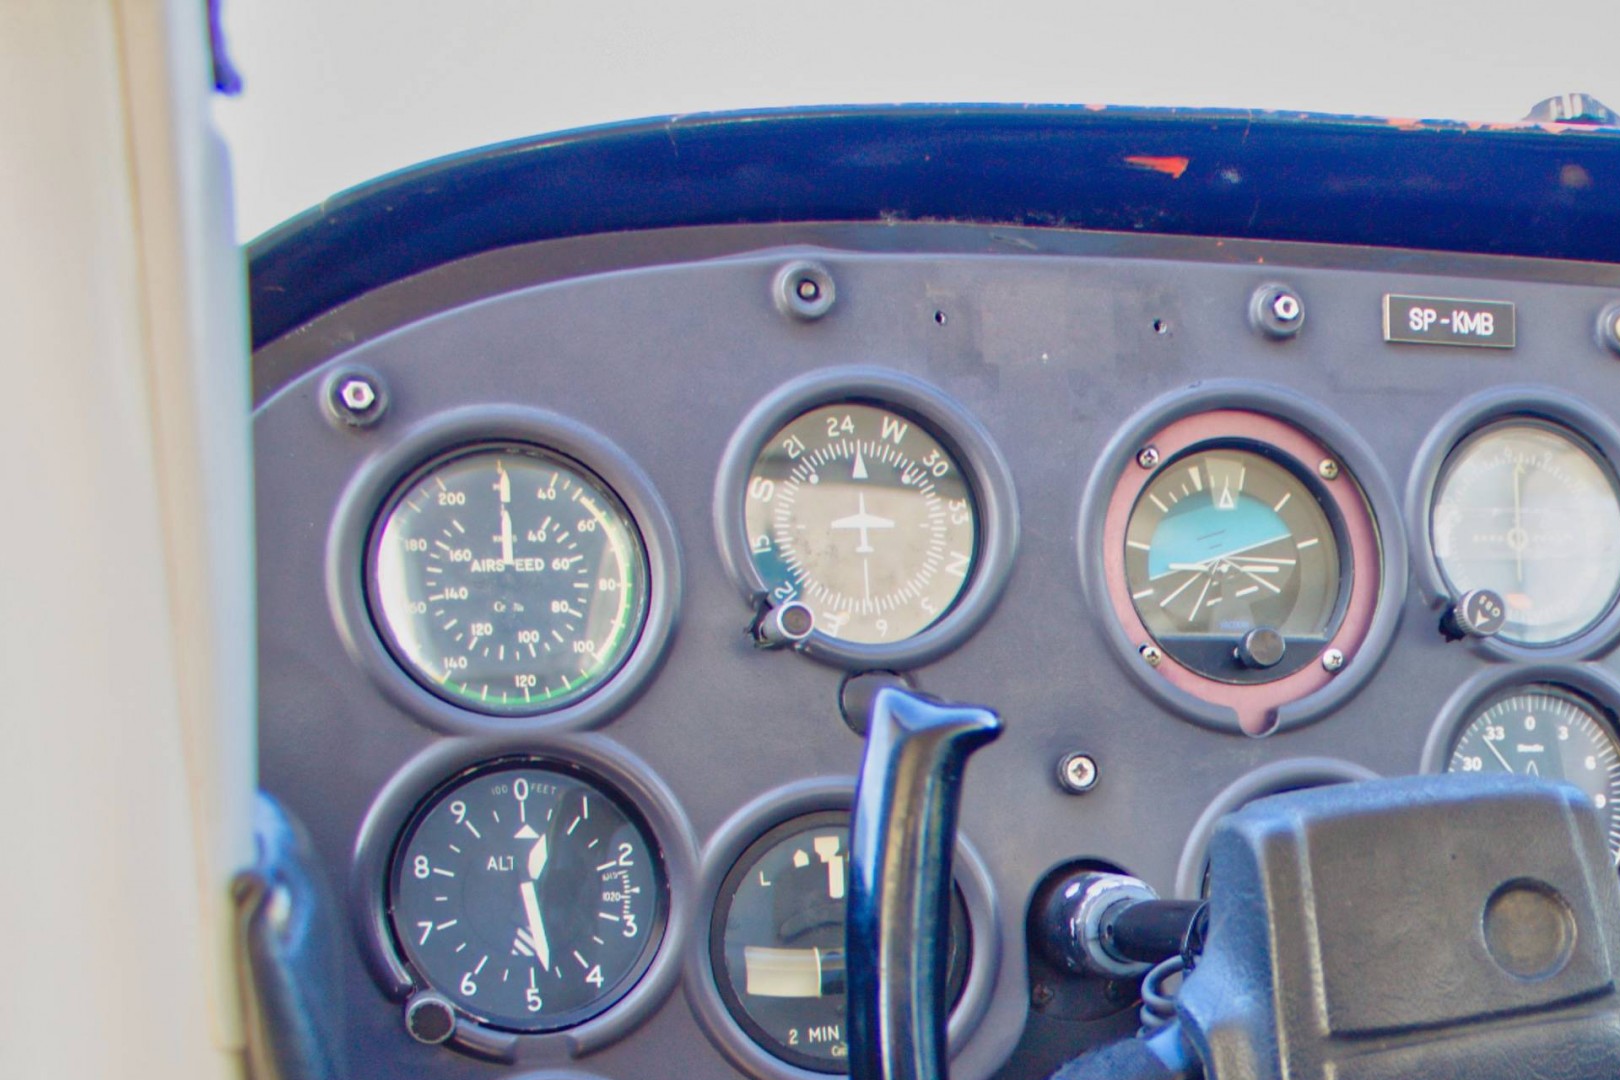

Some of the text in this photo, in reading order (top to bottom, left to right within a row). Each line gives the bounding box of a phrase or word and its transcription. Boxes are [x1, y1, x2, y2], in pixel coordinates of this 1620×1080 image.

[1409, 307, 1494, 336] SP-KMB
[827, 415, 854, 437] 24
[882, 416, 908, 444] W
[783, 435, 805, 459] 21
[922, 449, 949, 478] 30
[438, 492, 466, 505] 200
[537, 488, 556, 500] 40
[949, 499, 969, 525] 33
[577, 519, 596, 532] 60
[528, 530, 546, 542] 40
[404, 539, 427, 551] 180
[450, 550, 472, 562] 160
[552, 559, 570, 571] 60
[599, 579, 616, 591] 80
[444, 588, 468, 599] 140
[404, 602, 427, 614] 60
[551, 601, 568, 613] 80
[471, 624, 493, 636] 120
[518, 631, 540, 643] 100
[573, 641, 595, 653] 100
[444, 657, 467, 669] 140
[515, 675, 536, 688] 120
[1525, 716, 1535, 731] 0
[1485, 726, 1505, 740] 33
[1558, 726, 1568, 740] 3
[1462, 757, 1482, 771] 30
[1585, 756, 1596, 770] 6
[514, 779, 529, 801] 0
[450, 801, 466, 824] 9
[618, 843, 633, 866] 2
[414, 856, 429, 878] 8
[487, 856, 514, 871] ALT
[760, 871, 771, 886] L
[623, 914, 637, 937] 3
[418, 923, 432, 945] 7
[586, 965, 604, 987] 4
[461, 973, 476, 995] 6
[527, 989, 542, 1011] 5
[789, 1025, 840, 1044] 2 MIN
